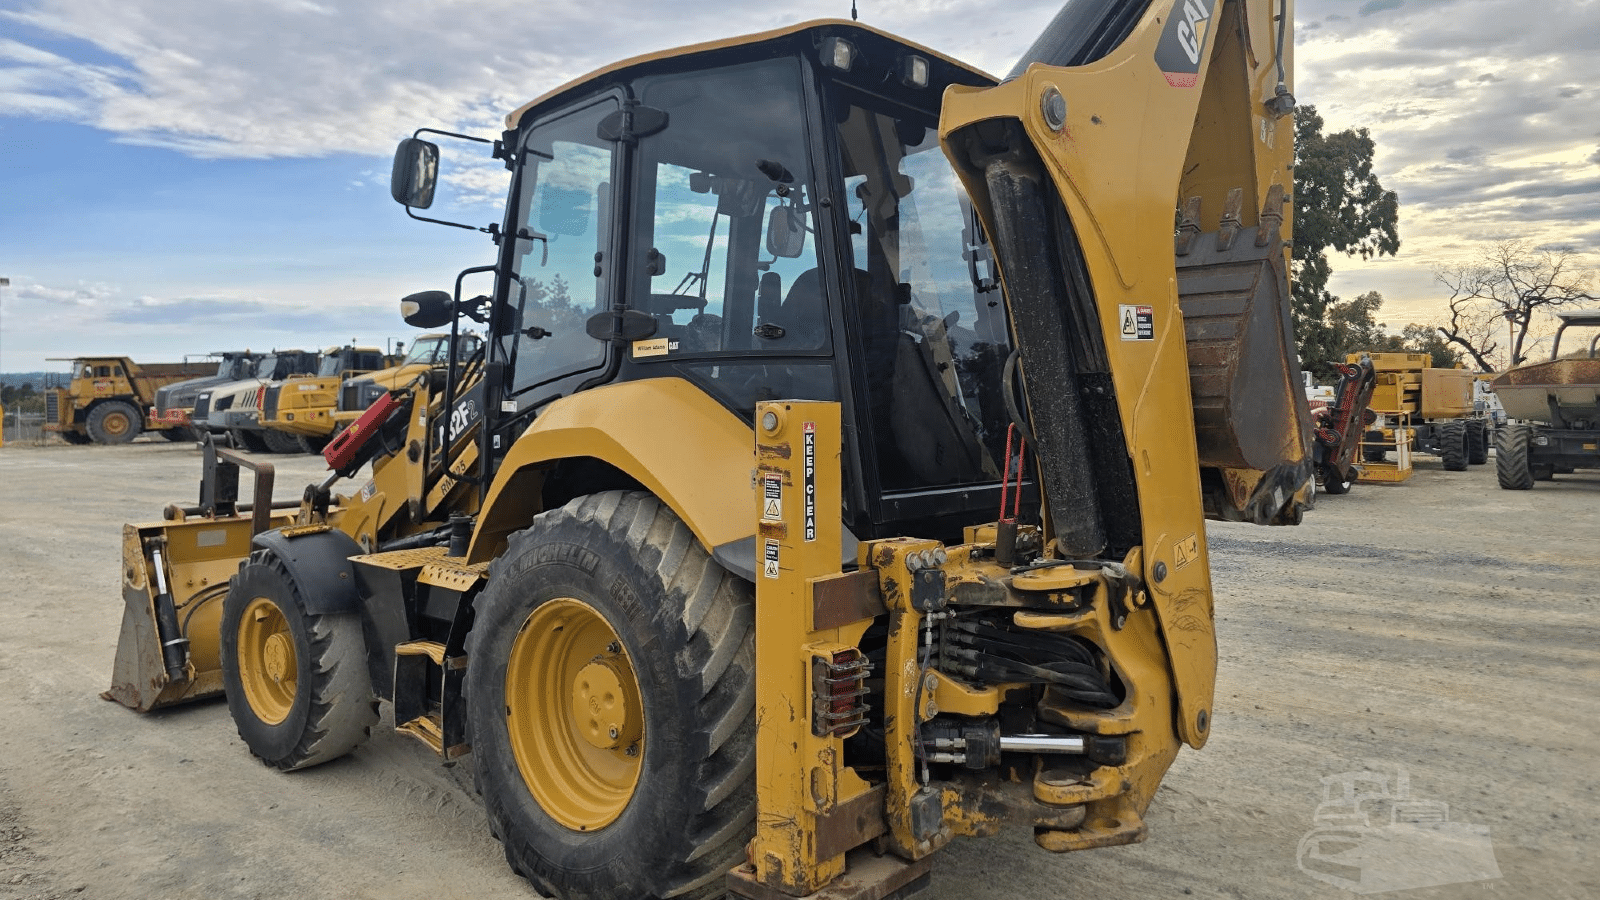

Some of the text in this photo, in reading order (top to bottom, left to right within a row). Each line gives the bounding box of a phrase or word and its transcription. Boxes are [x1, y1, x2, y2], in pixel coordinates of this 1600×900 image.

[439, 400, 479, 446] 32F2
[805, 434, 814, 478] KEEP
[806, 484, 815, 539] CLEAR
